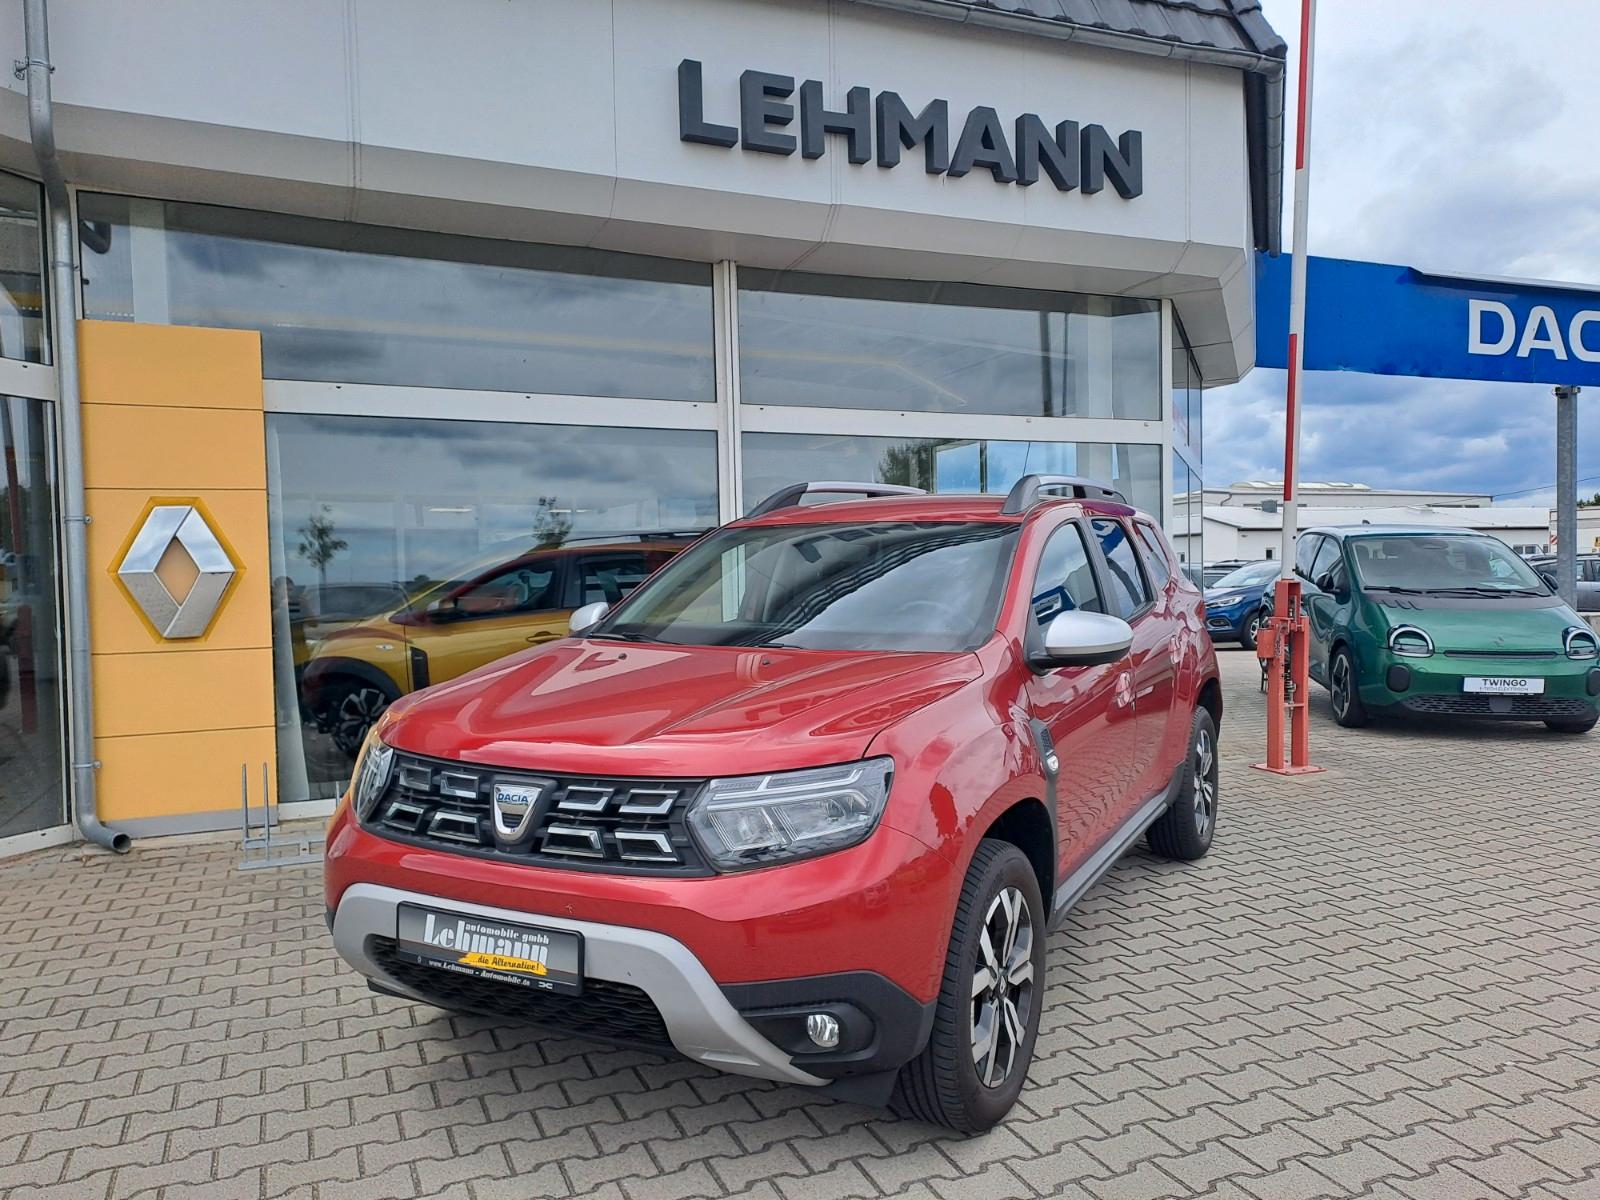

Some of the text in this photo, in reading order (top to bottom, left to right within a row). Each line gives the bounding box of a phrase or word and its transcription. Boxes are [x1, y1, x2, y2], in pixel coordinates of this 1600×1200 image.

[678, 59, 1143, 199] LEHMANN
[1468, 299, 1600, 363] DAC
[1482, 679, 1527, 687] TWINGO
[497, 793, 529, 803] DACIA
[424, 914, 548, 967] Lehmann
[465, 924, 549, 944] automobile gmbh
[492, 957, 539, 971] Alternative!
